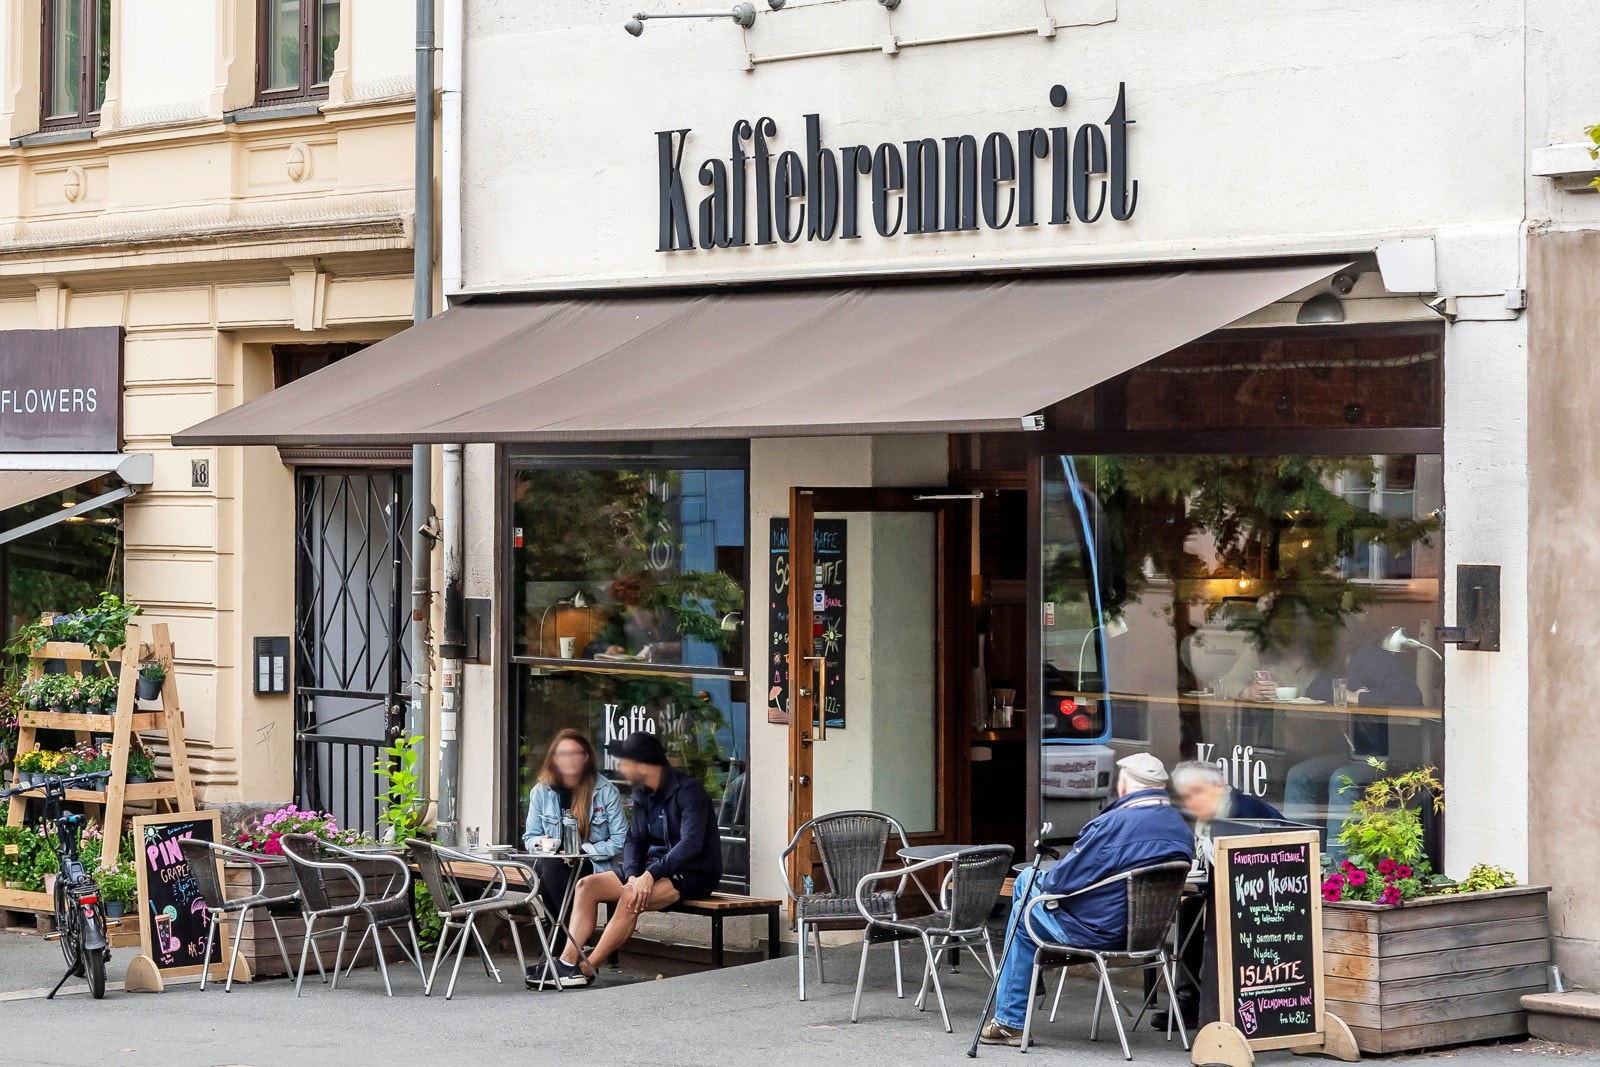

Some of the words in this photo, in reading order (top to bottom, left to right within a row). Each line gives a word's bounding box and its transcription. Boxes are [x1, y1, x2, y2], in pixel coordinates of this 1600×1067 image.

[655, 81, 1139, 252] Kaffebrenneriet
[1, 388, 97, 413] FLOWERS
[193, 464, 206, 483] 48
[1235, 873, 1264, 906] KOKO
[1240, 932, 1252, 948] Nyt
[1256, 933, 1282, 944] sammen
[1253, 947, 1280, 965] Nydelig
[1240, 960, 1304, 986] ISLATTE
